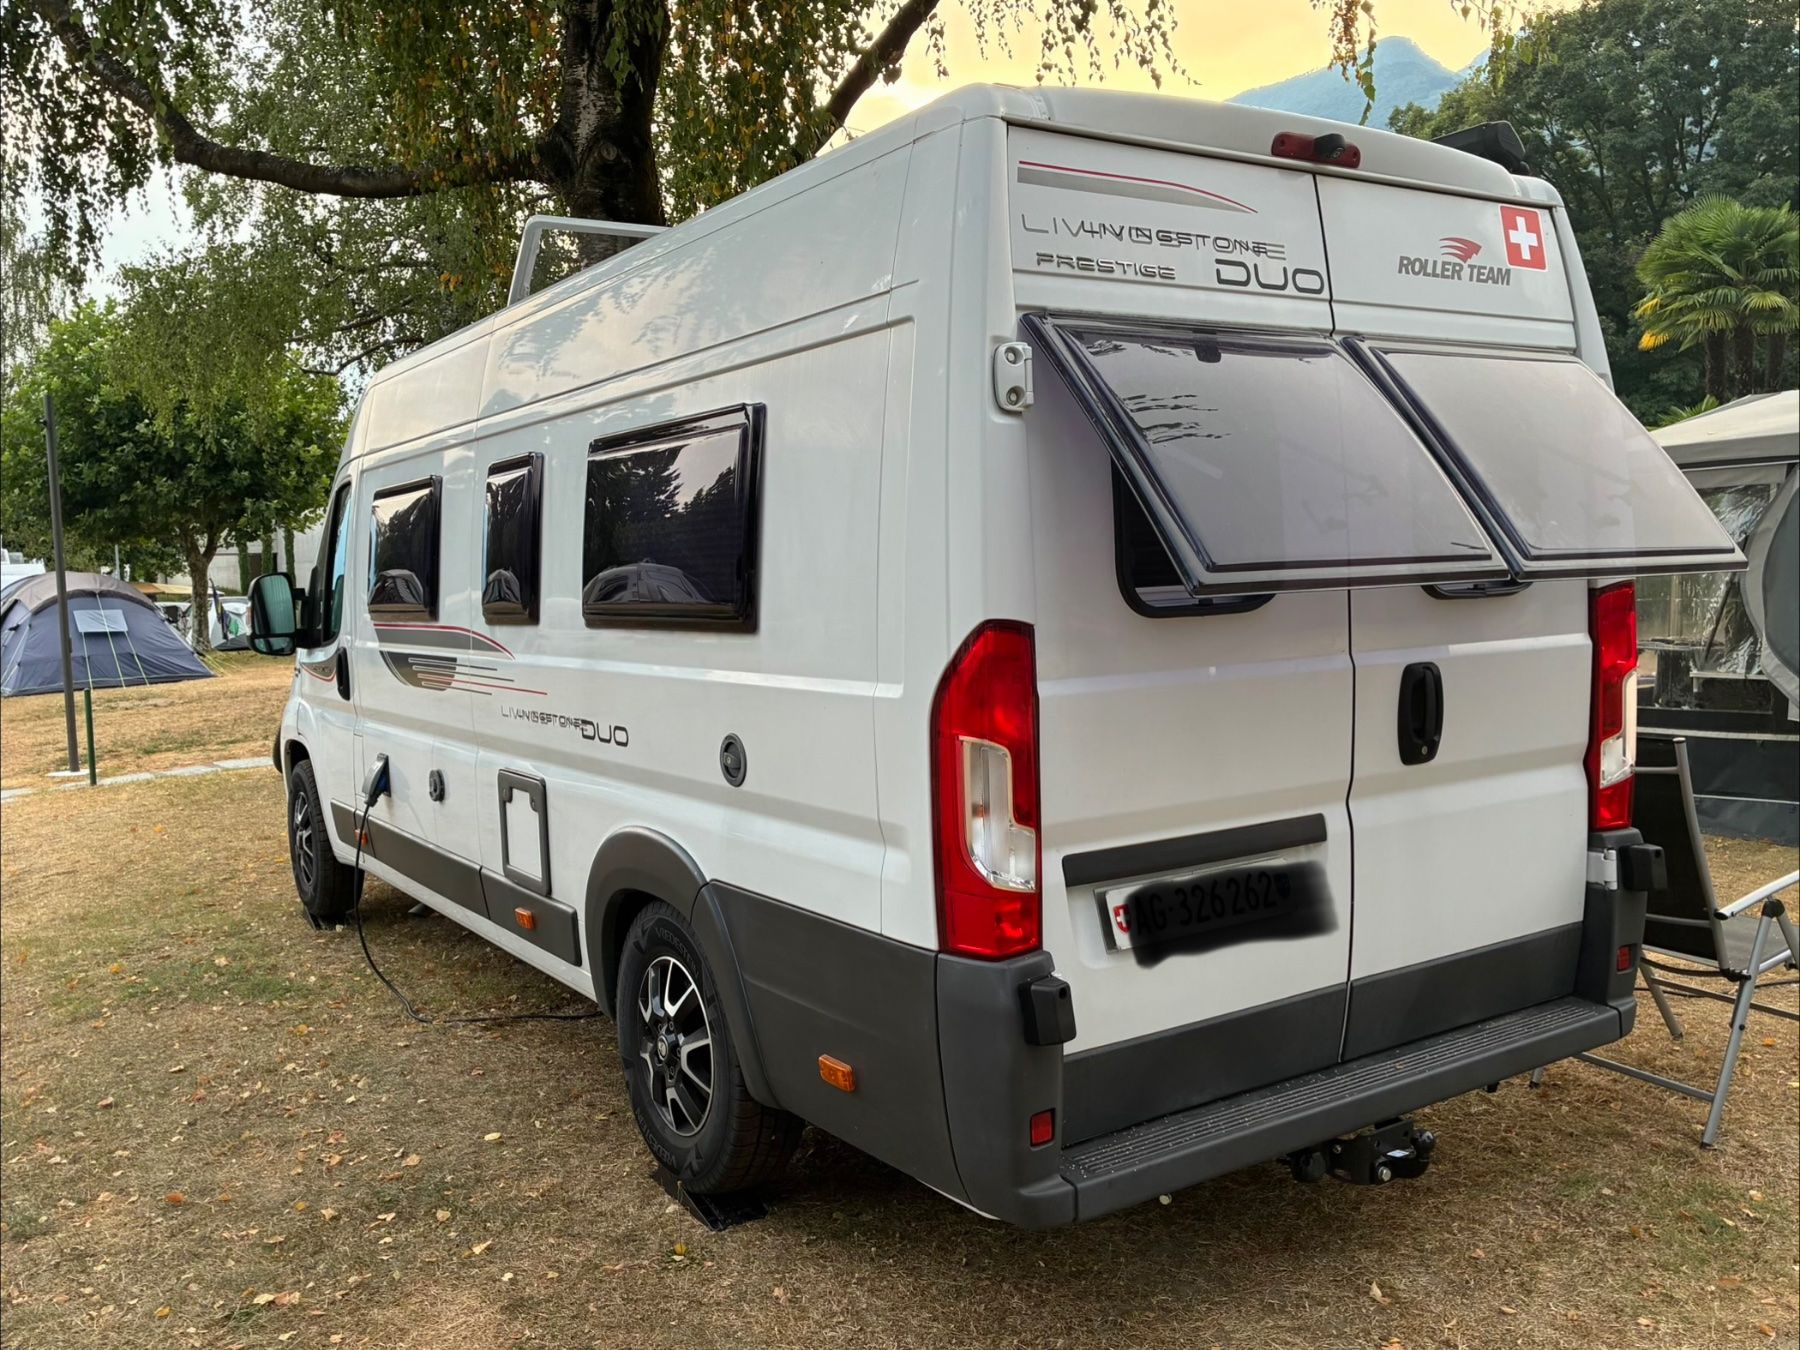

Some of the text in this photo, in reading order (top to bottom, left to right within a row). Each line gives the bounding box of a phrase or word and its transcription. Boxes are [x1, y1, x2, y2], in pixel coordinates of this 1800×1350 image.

[1036, 251, 1325, 294] PRESTIGE DUO
[1397, 255, 1511, 286] ROLLER TEAM
[580, 719, 629, 747] DUO
